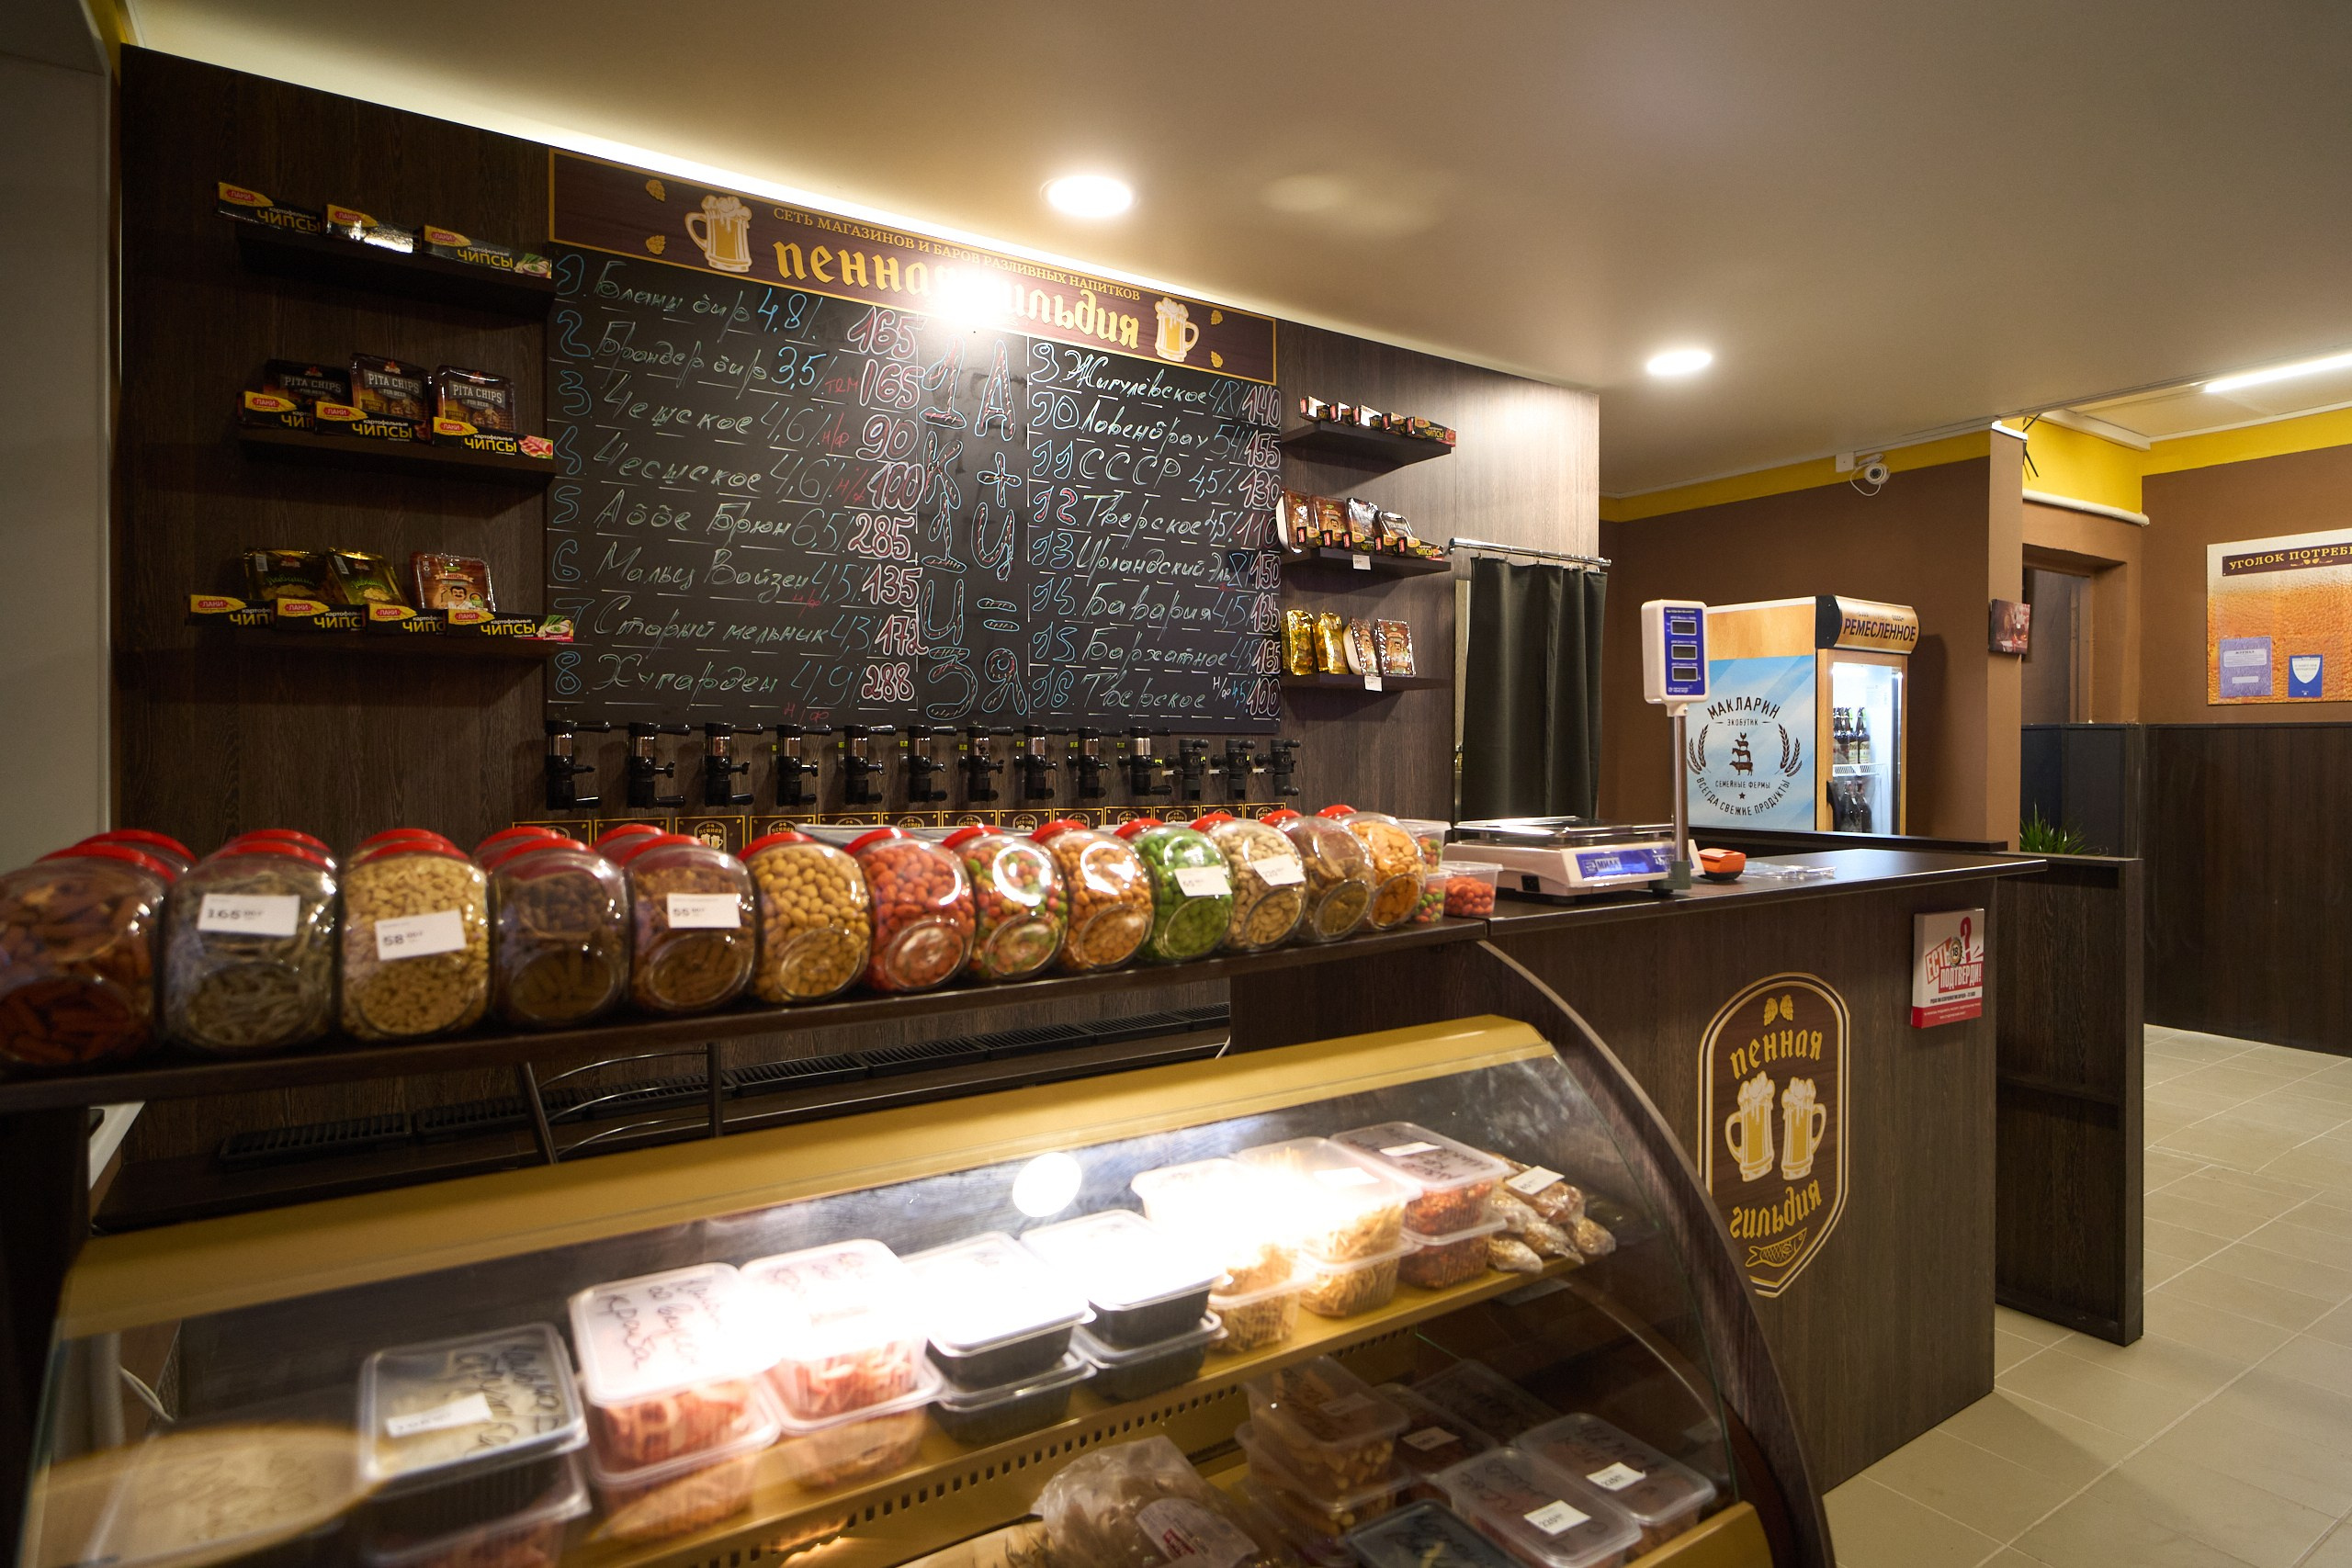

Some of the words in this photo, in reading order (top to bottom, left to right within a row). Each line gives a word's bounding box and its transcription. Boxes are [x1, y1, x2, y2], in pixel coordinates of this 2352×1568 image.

[257, 209, 321, 233] ЧИПСЫ
[457, 249, 514, 269] ЧИПСЫ
[773, 207, 813, 227] СЕТЬ
[817, 217, 915, 250] МАГАЗИНОВ
[919, 240, 930, 254] И
[933, 243, 981, 265] БАРОВ
[984, 255, 1067, 285] РАЗЛИВНЫХ
[1069, 275, 1141, 302] НАПИТКОВ
[998, 278, 1140, 350] ильдия
[847, 305, 928, 360] 165
[285, 376, 308, 388] PITA
[311, 379, 343, 393] CHIPS
[368, 373, 390, 387] PITA
[391, 378, 420, 394] CHIPS
[452, 383, 474, 397] PITA
[475, 388, 503, 404] CHIPS
[859, 358, 926, 410] 165
[280, 415, 313, 428] ЧИП
[1242, 385, 1282, 427] 140
[352, 423, 413, 439] ЧИПСЫ
[464, 437, 517, 453] ЧИПСЫ
[855, 413, 920, 461] 90
[1244, 429, 1281, 469] 155
[867, 461, 925, 512] 100
[1080, 447, 1182, 490] СССР
[1238, 468, 1282, 510] 130
[848, 512, 915, 561] 285
[1250, 550, 1282, 590] 150
[2229, 553, 2285, 570] УГОЛОК
[861, 563, 923, 608] 135
[230, 613, 270, 626] ЧИП
[313, 616, 362, 628] ЧИПС
[402, 621, 446, 633] ЧИПС
[1250, 591, 1281, 633] 135
[481, 623, 536, 636] ЧИПСЫ
[875, 614, 929, 657] 172
[1843, 617, 1917, 642] РЕМЕСЛЕННОЕ
[1251, 637, 1281, 674] 165
[861, 662, 915, 703] 288
[1247, 677, 1281, 717] 100
[1707, 696, 1781, 719] МАКЛАРИН
[1727, 718, 1758, 727] ЭКОБУТИК
[1696, 776, 1719, 807] ВСЕГДА
[1719, 801, 1752, 817] СВЕЖИЕ
[1754, 779, 1791, 815] ПРОДУКТЫ
[1714, 780, 1746, 788] СЕМЕЙНЫЕ
[1748, 780, 1770, 789] ФЕРМЫ
[1939, 963, 1982, 990] ПОДТВЕРДИ!
